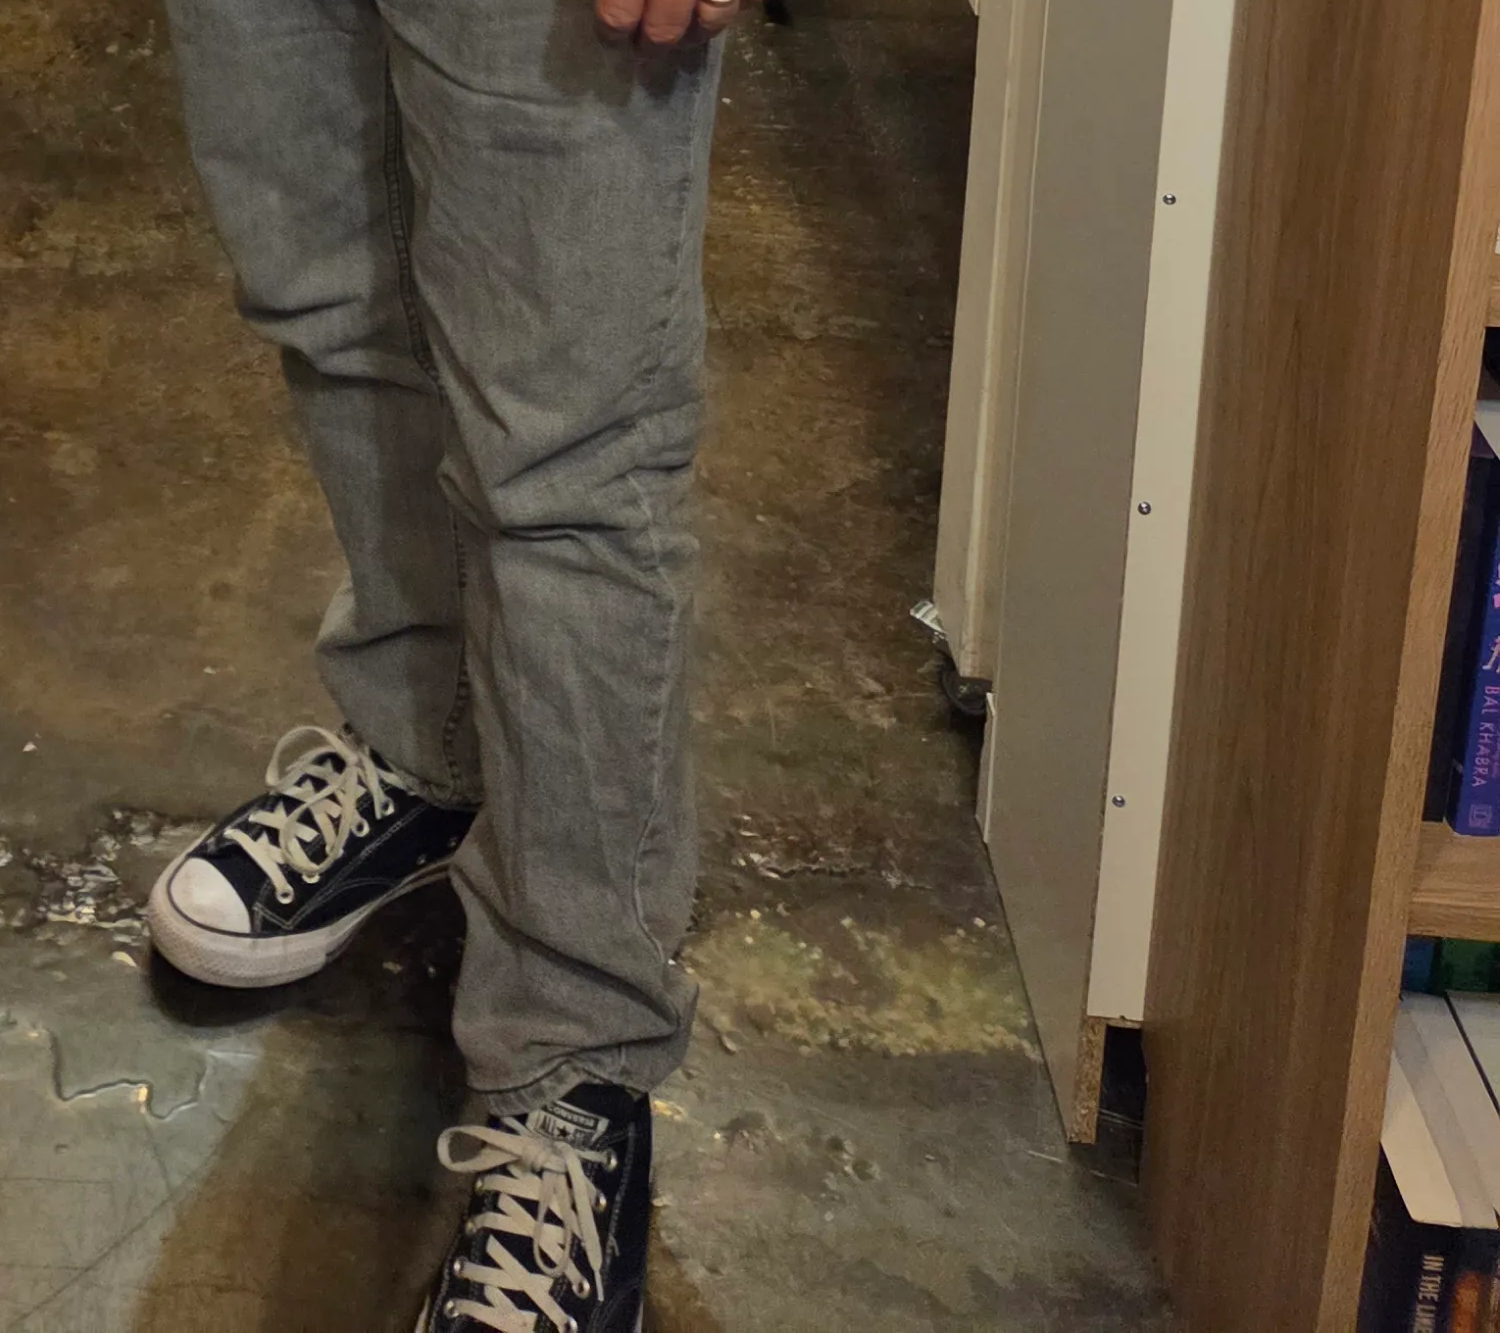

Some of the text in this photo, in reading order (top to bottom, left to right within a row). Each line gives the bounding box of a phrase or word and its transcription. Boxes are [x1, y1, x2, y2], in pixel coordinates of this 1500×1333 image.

[1471, 685, 1500, 788] BAL KHABRA
[1421, 1254, 1445, 1272] IN
[1418, 1274, 1442, 1303] THE
